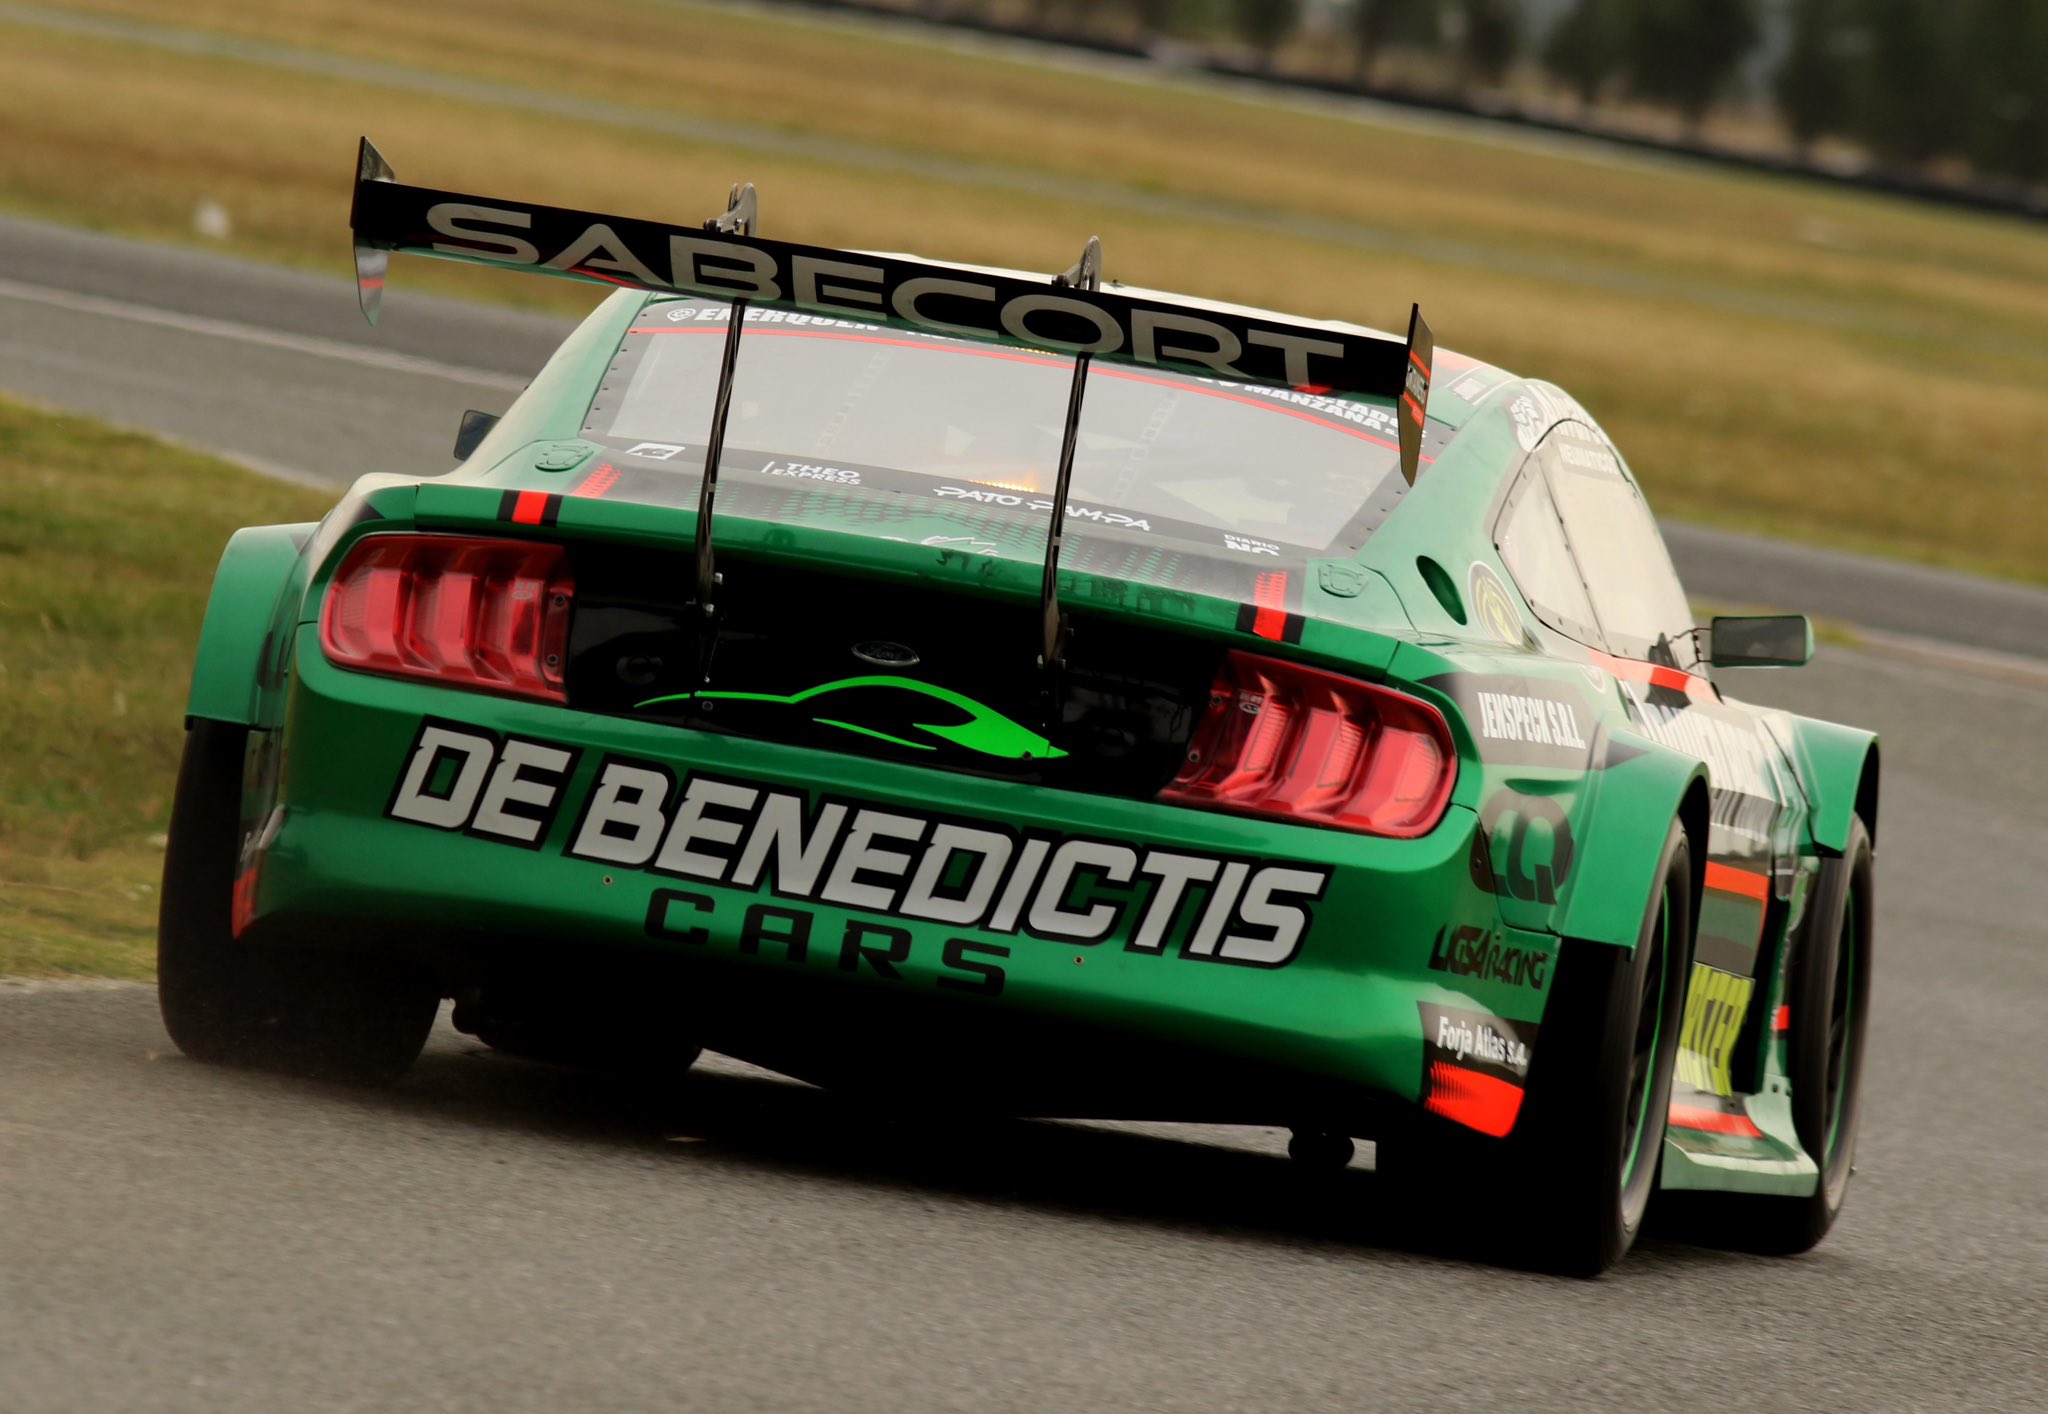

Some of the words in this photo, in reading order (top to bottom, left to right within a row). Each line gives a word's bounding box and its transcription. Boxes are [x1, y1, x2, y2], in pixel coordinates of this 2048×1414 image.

[425, 202, 1345, 388] SABECORT
[1243, 384, 1382, 431] MANZANA
[771, 467, 861, 485] EXPRESS
[787, 463, 861, 478] THEO
[933, 486, 1024, 506] PATO
[1224, 533, 1280, 550] DIARIO
[389, 725, 574, 843] DE
[570, 762, 1326, 965] BENEDICTIS
[643, 887, 1012, 996] CARS
[1436, 1015, 1473, 1061] Forja
